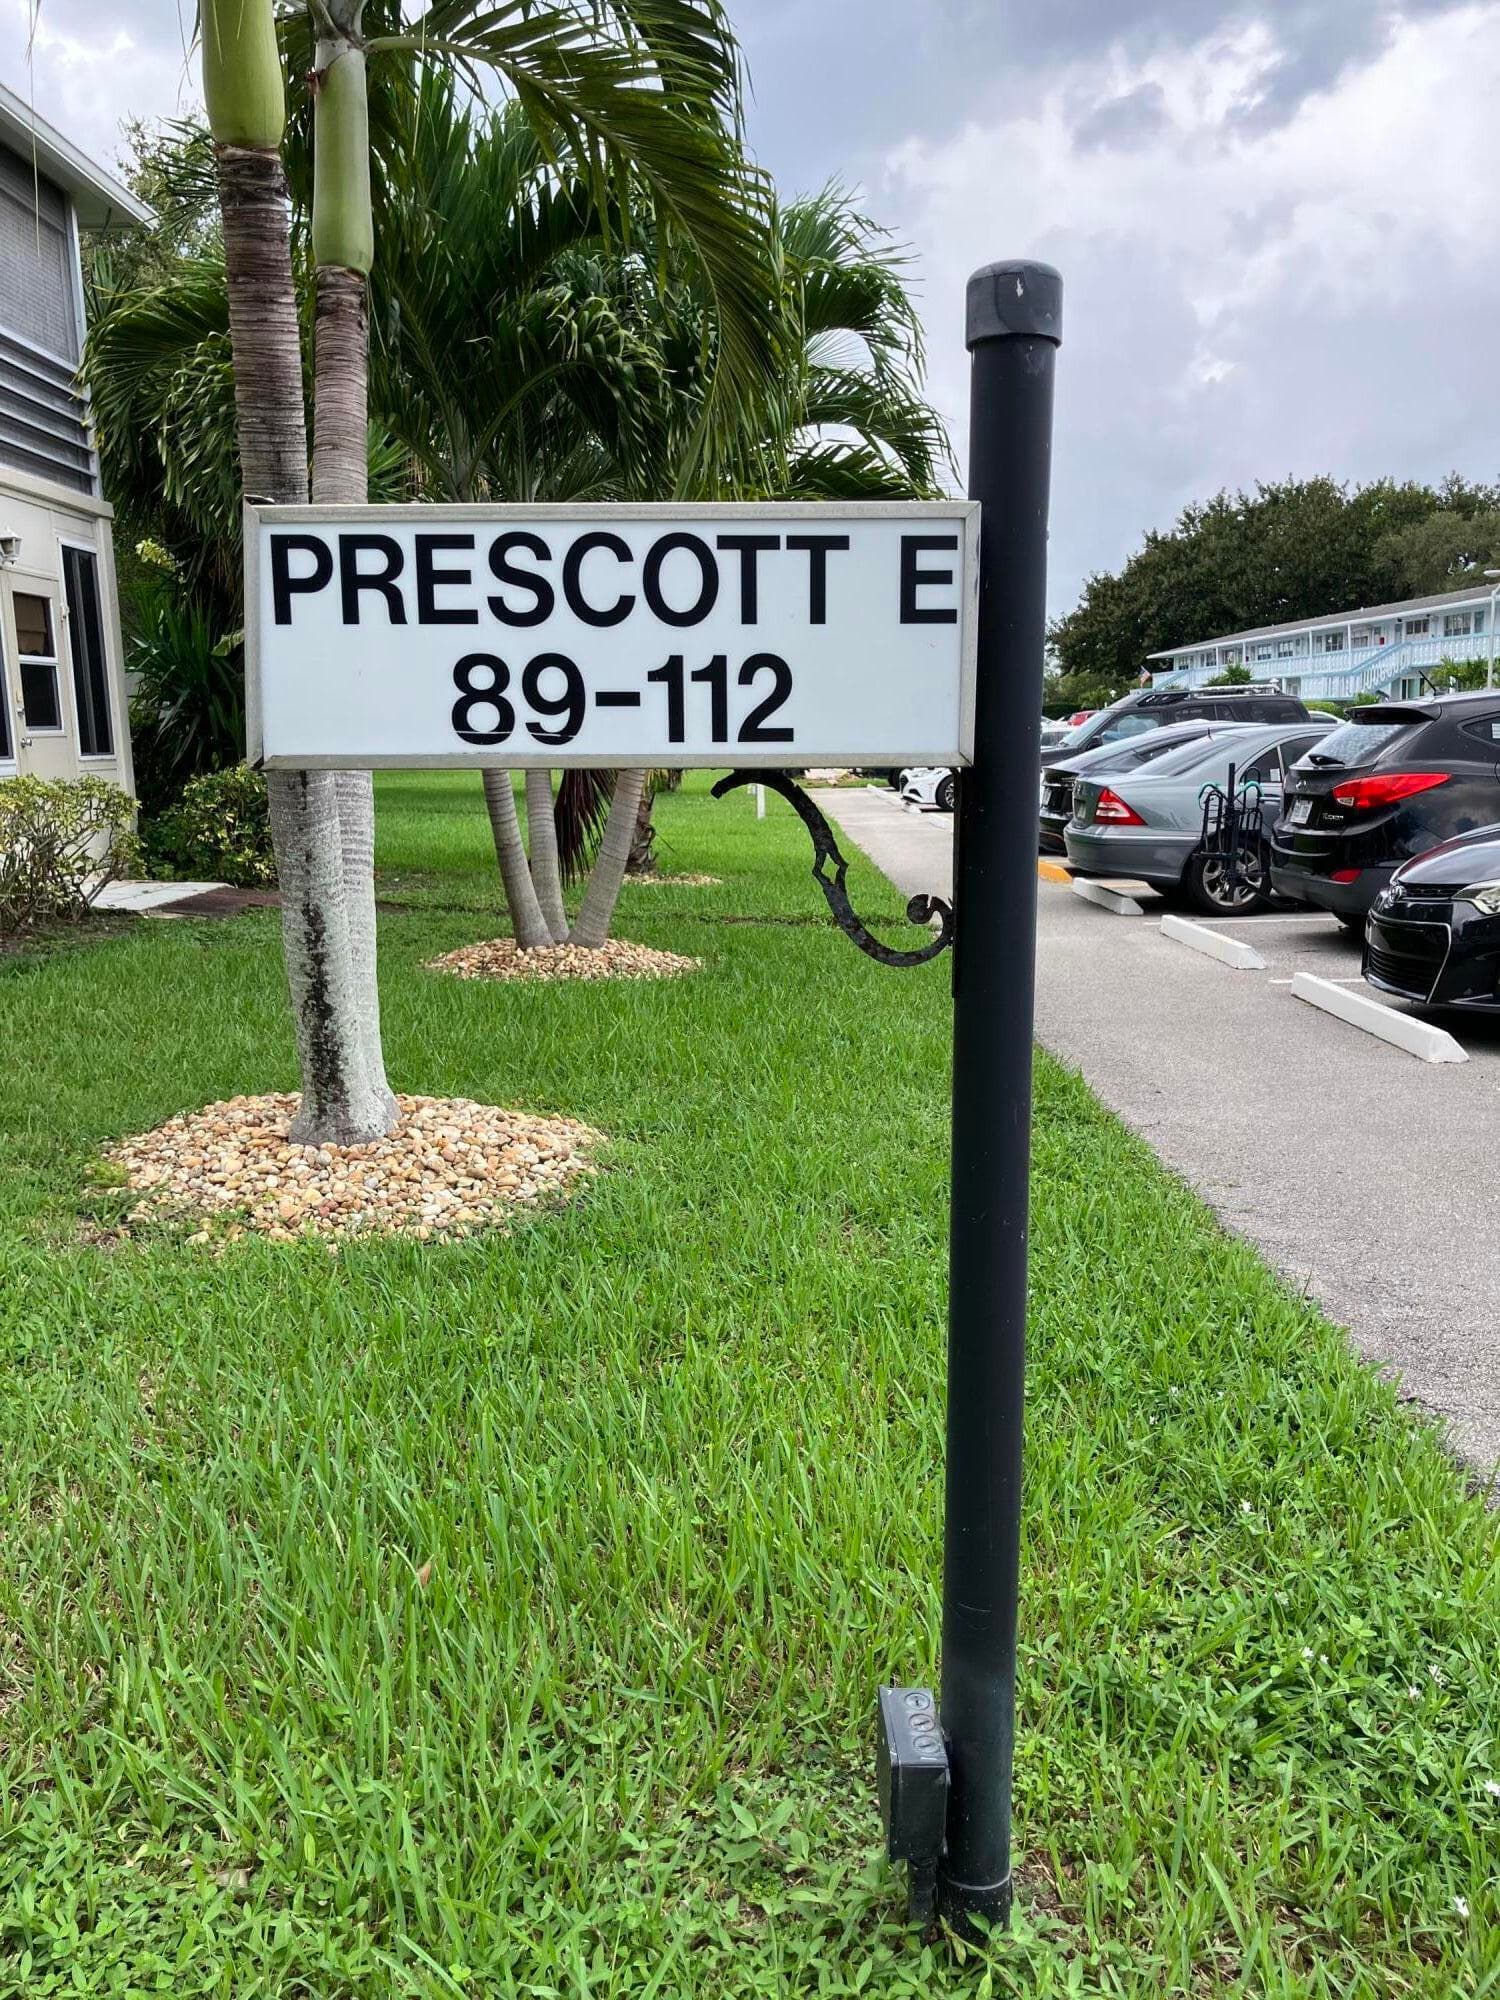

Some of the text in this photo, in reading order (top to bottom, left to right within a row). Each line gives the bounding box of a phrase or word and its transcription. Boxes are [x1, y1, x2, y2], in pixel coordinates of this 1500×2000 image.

[270, 531, 958, 628] PRESCOTT E
[451, 652, 794, 746] 89-112
